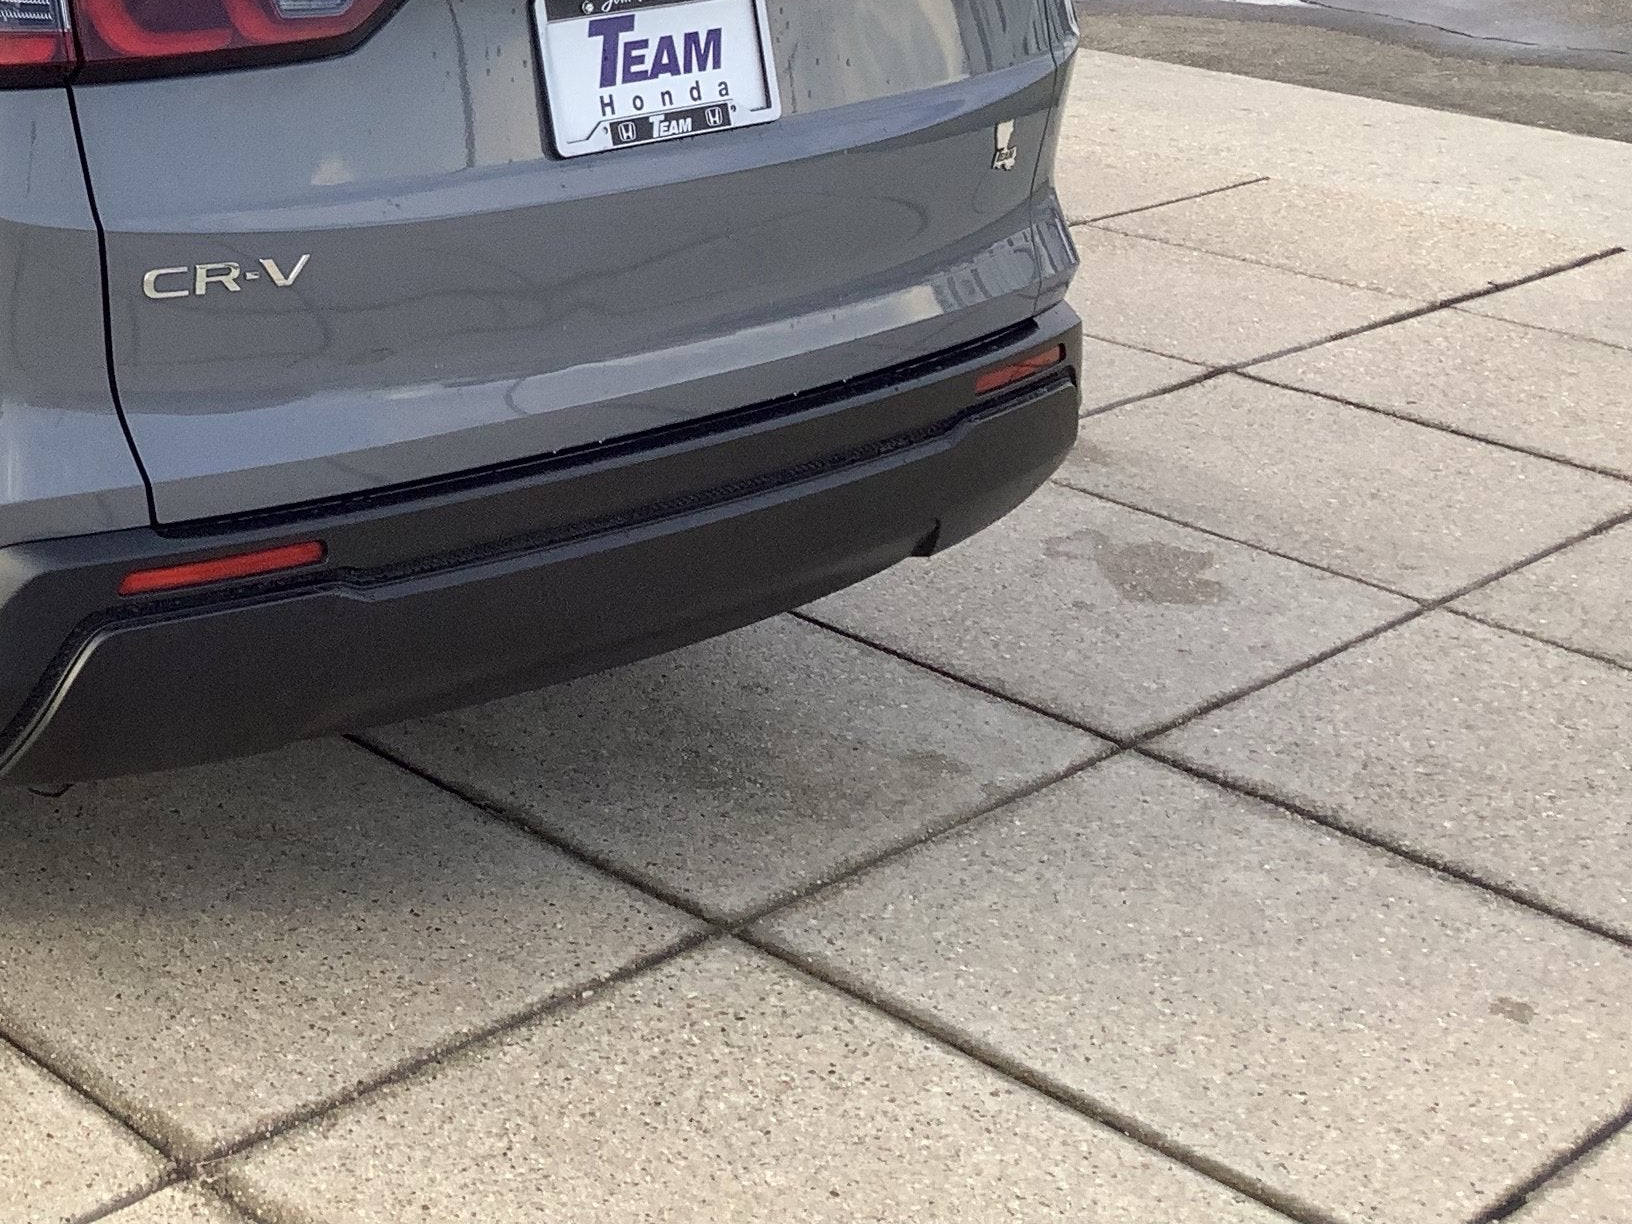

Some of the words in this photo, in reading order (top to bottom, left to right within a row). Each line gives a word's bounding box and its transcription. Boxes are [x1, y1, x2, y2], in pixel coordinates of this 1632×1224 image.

[588, 14, 722, 88] TEAM
[599, 80, 729, 117] Honda
[649, 114, 693, 138] TEAM
[143, 253, 311, 299] CR-V
